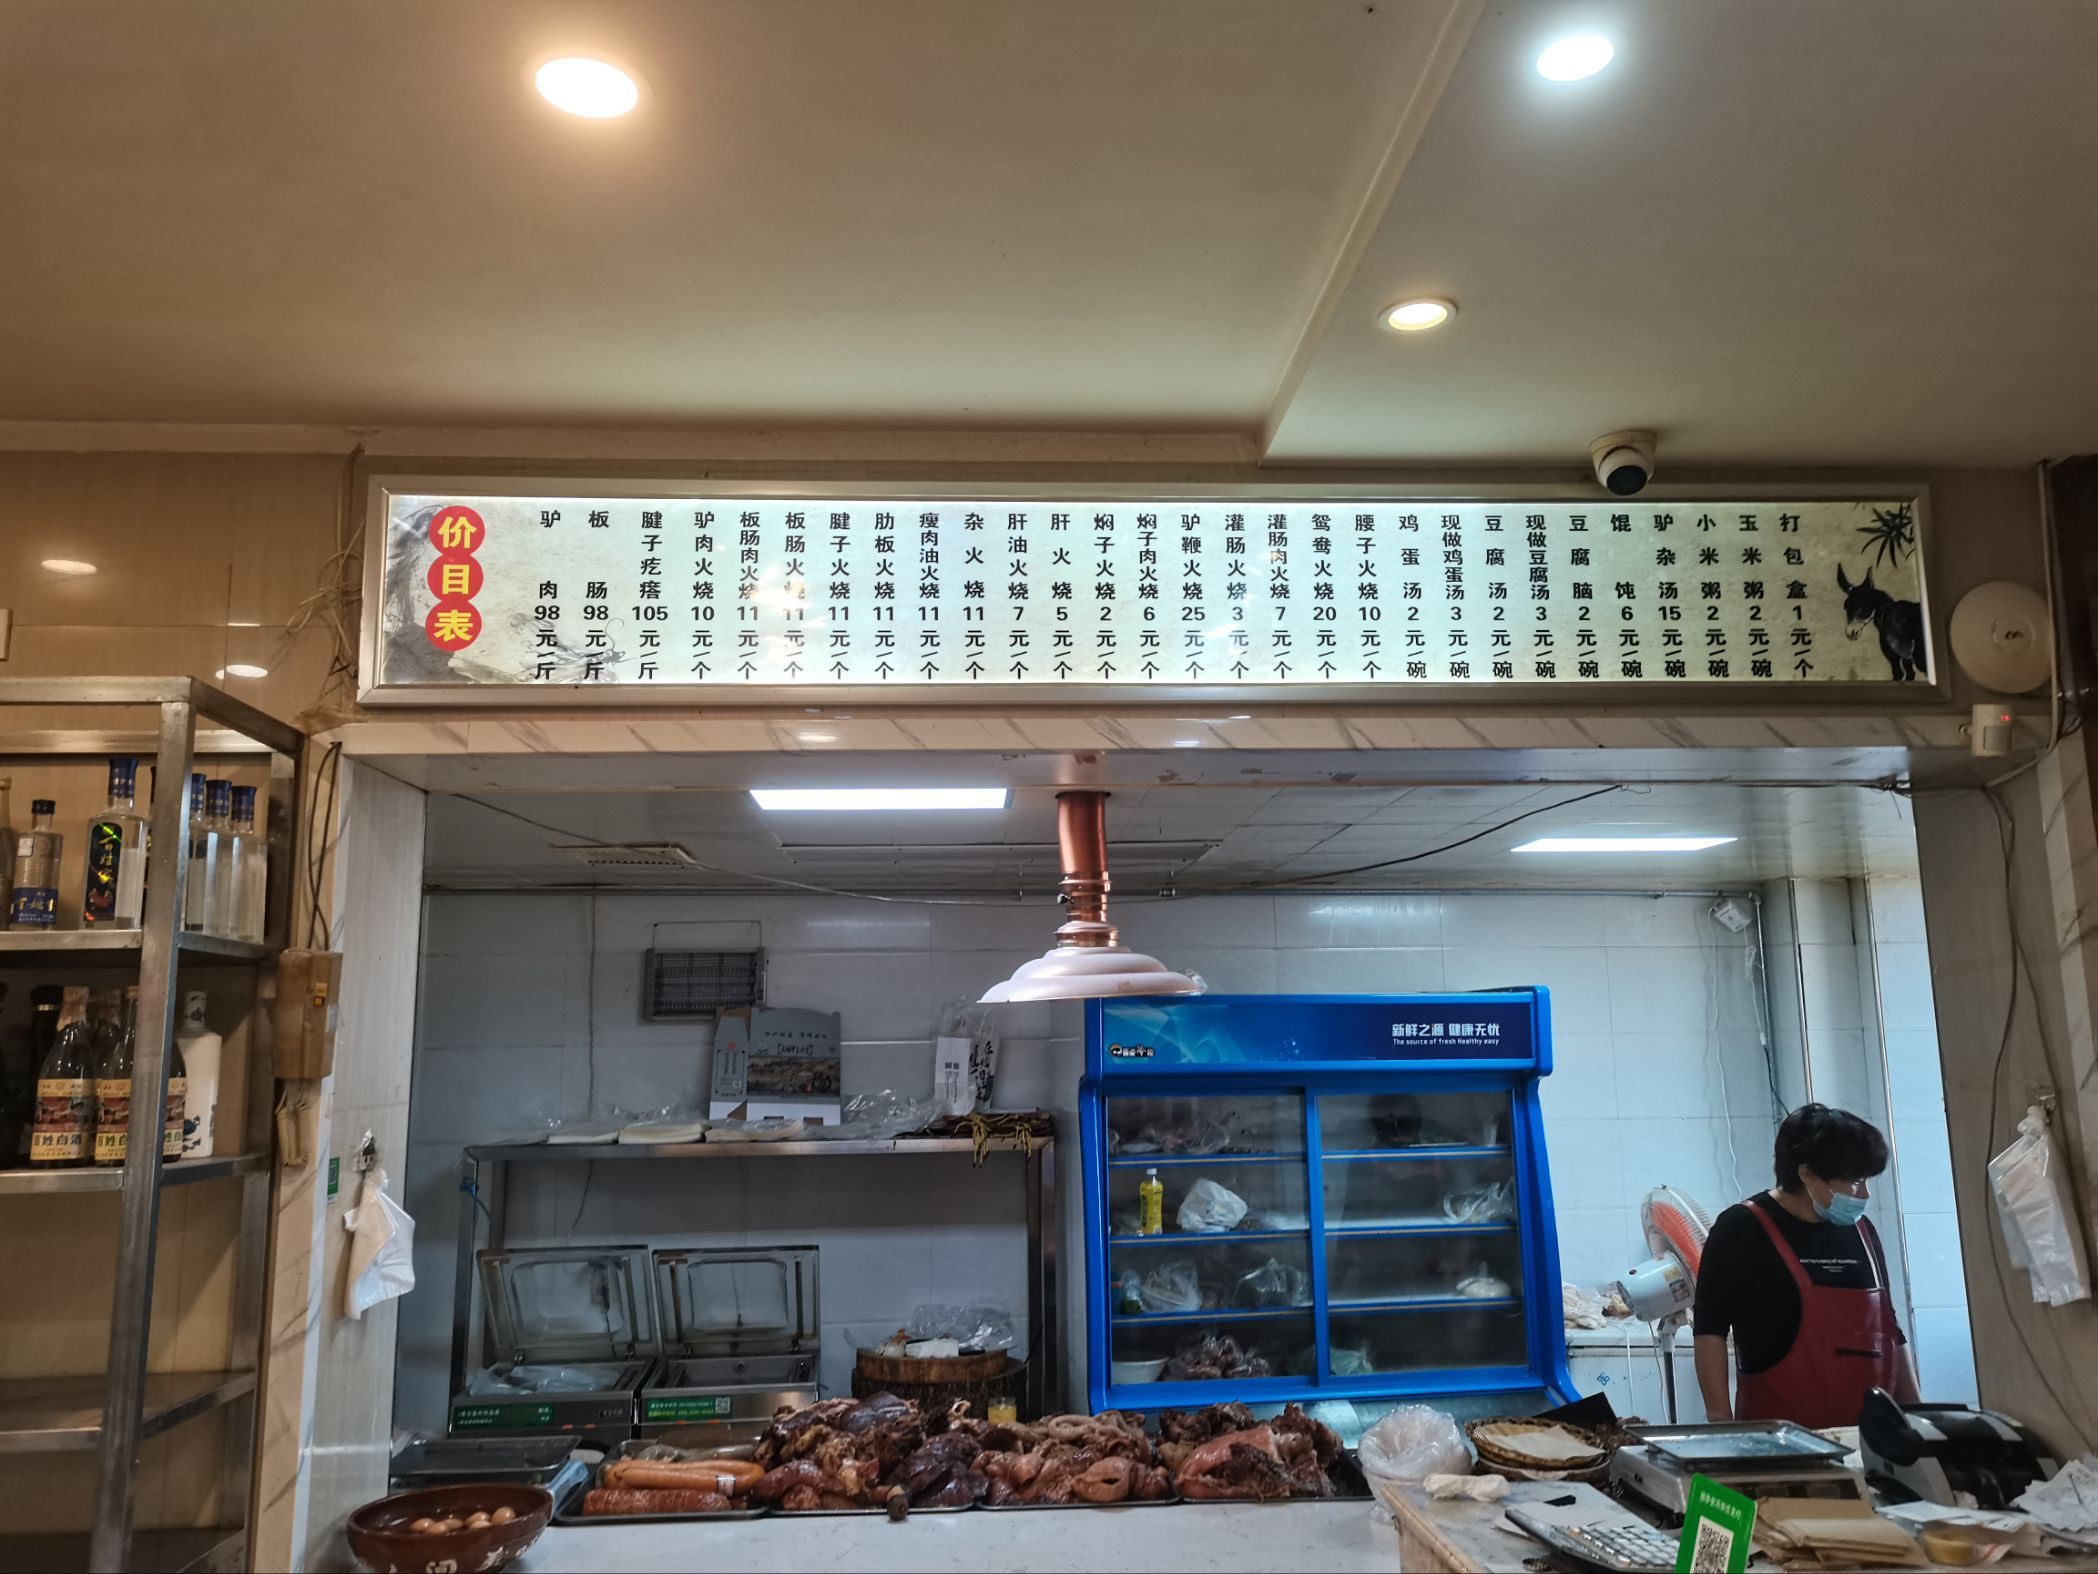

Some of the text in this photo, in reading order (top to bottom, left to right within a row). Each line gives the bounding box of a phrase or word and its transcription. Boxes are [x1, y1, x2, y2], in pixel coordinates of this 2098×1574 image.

[434, 516, 477, 642] 价目表
[1392, 1023, 1500, 1036] 新鲜之源 健康无忧
[1484, 1038, 1499, 1046] easy
